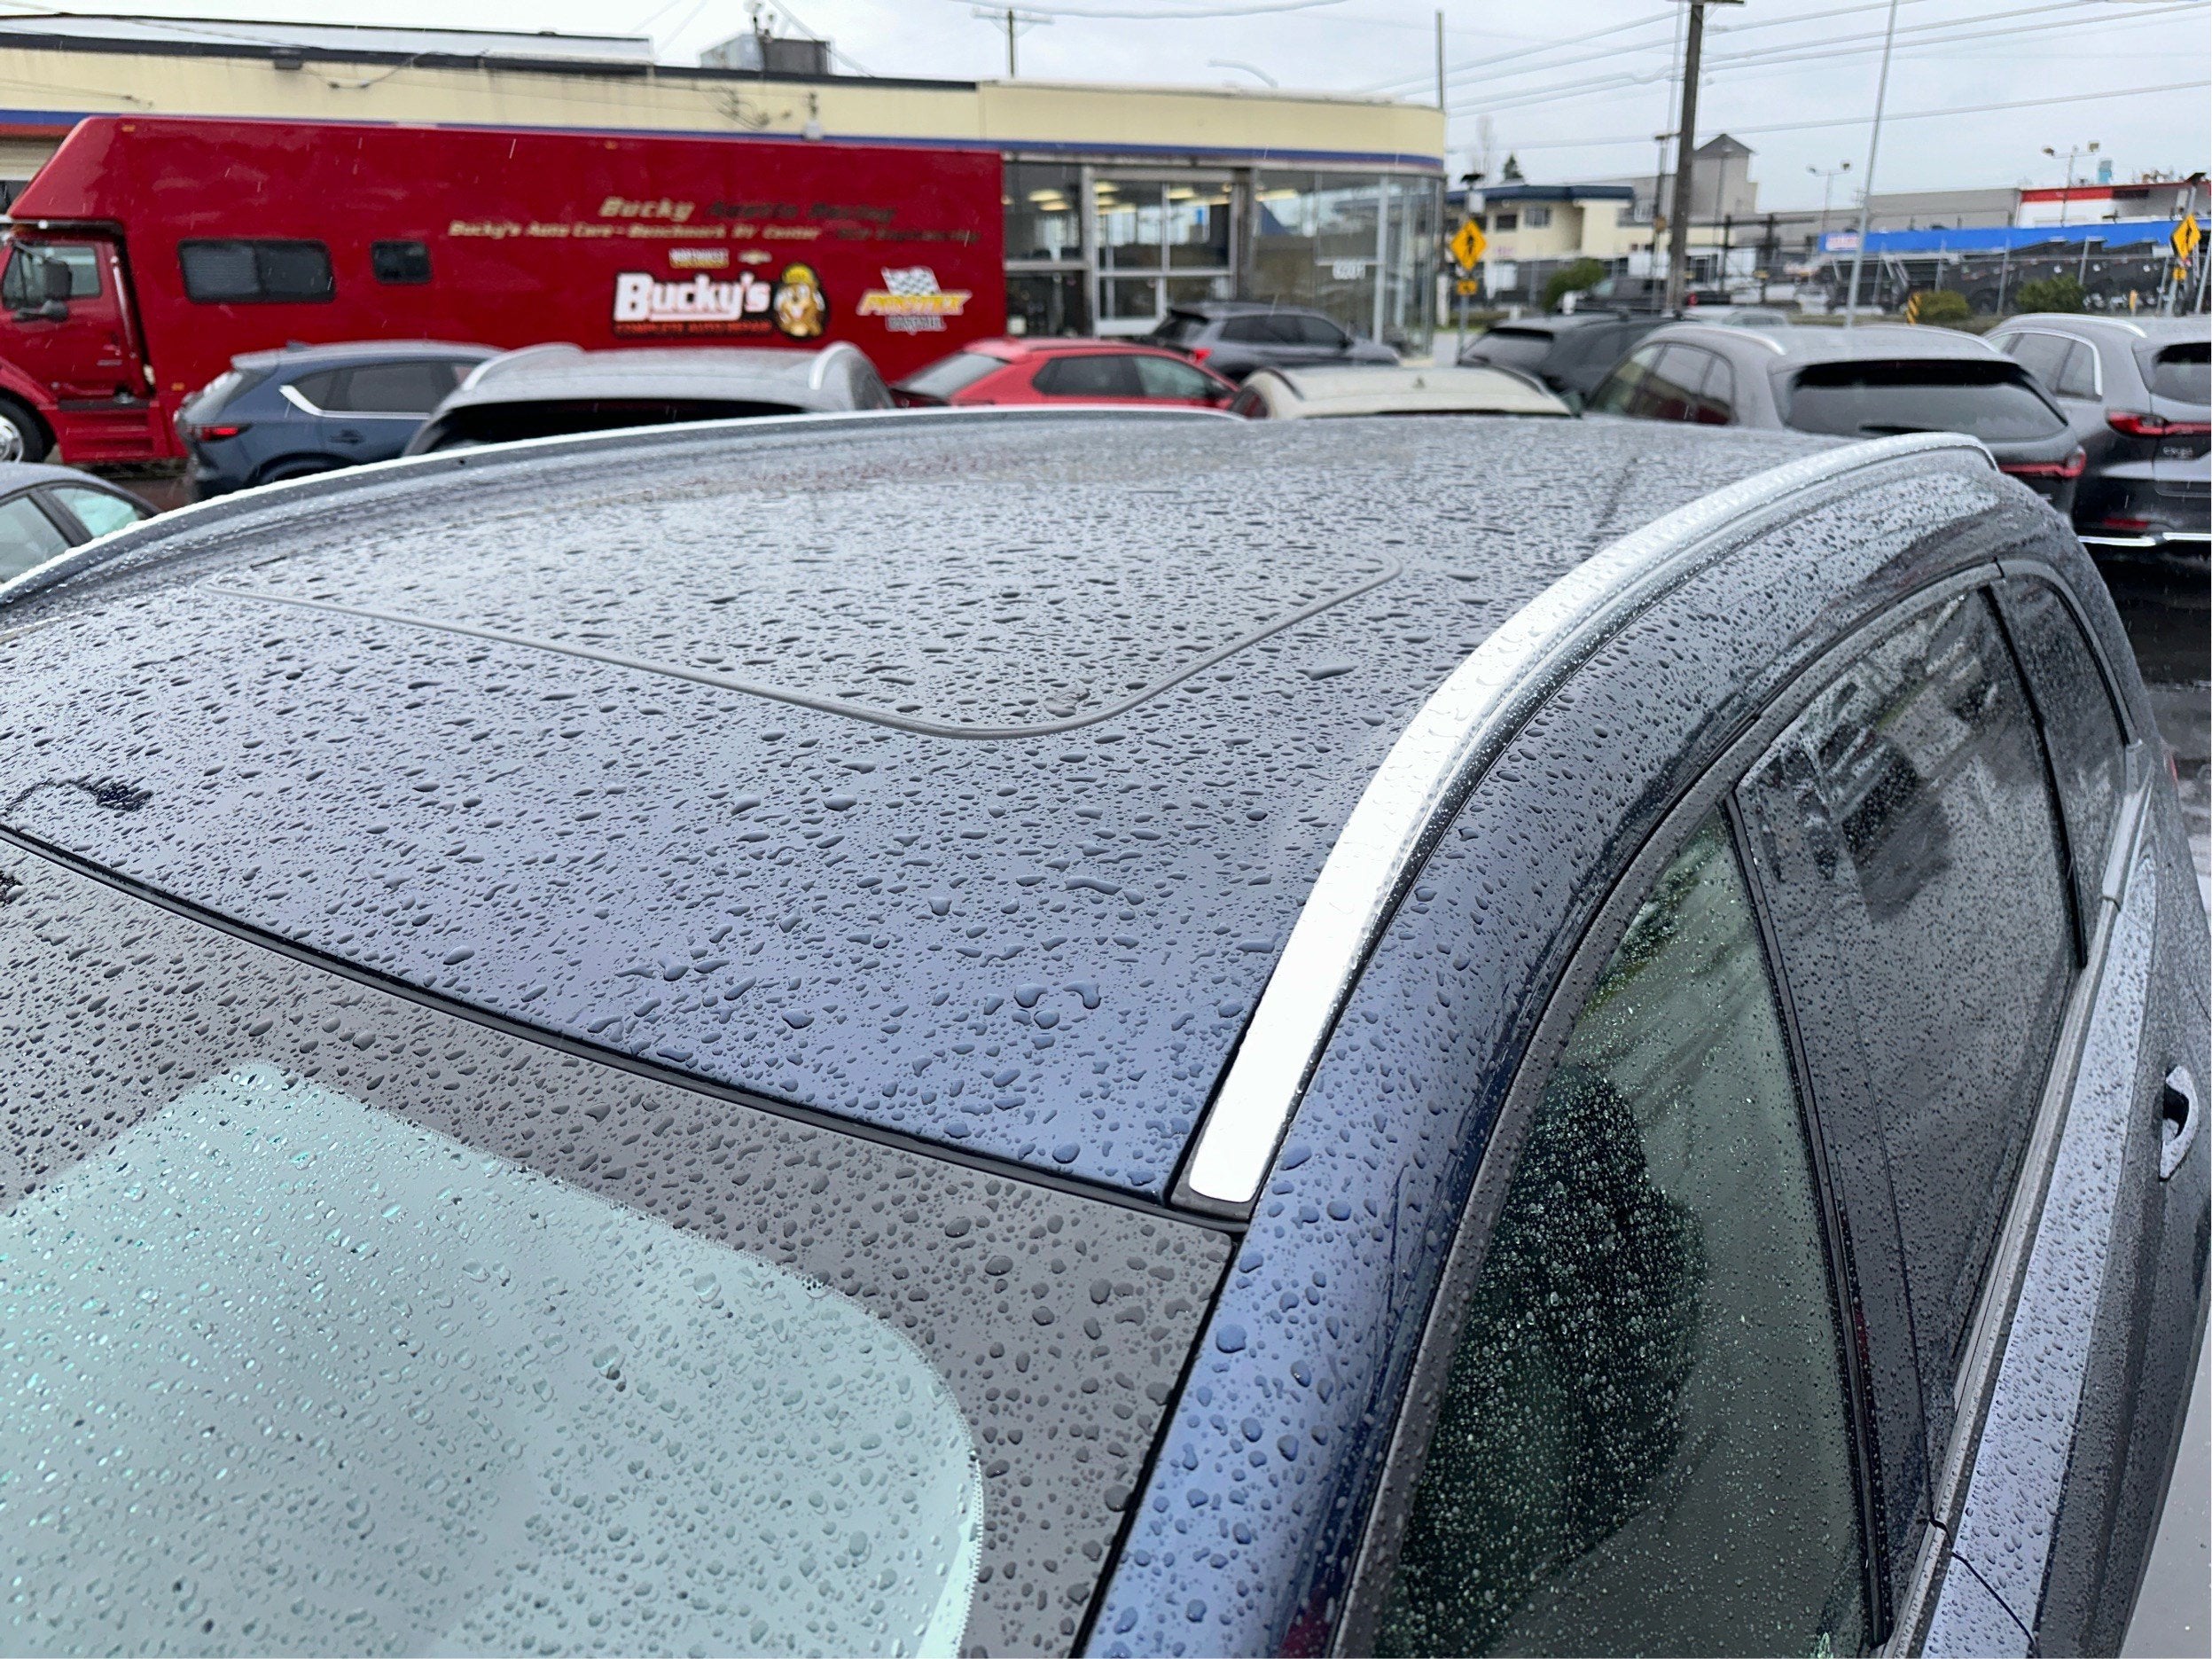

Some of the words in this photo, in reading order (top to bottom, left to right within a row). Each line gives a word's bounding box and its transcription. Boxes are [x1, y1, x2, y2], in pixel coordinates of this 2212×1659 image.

[599, 196, 695, 222] Bucky
[449, 221, 521, 239] Bucky's
[525, 221, 570, 238] Auto
[614, 270, 772, 322] Bucky's
